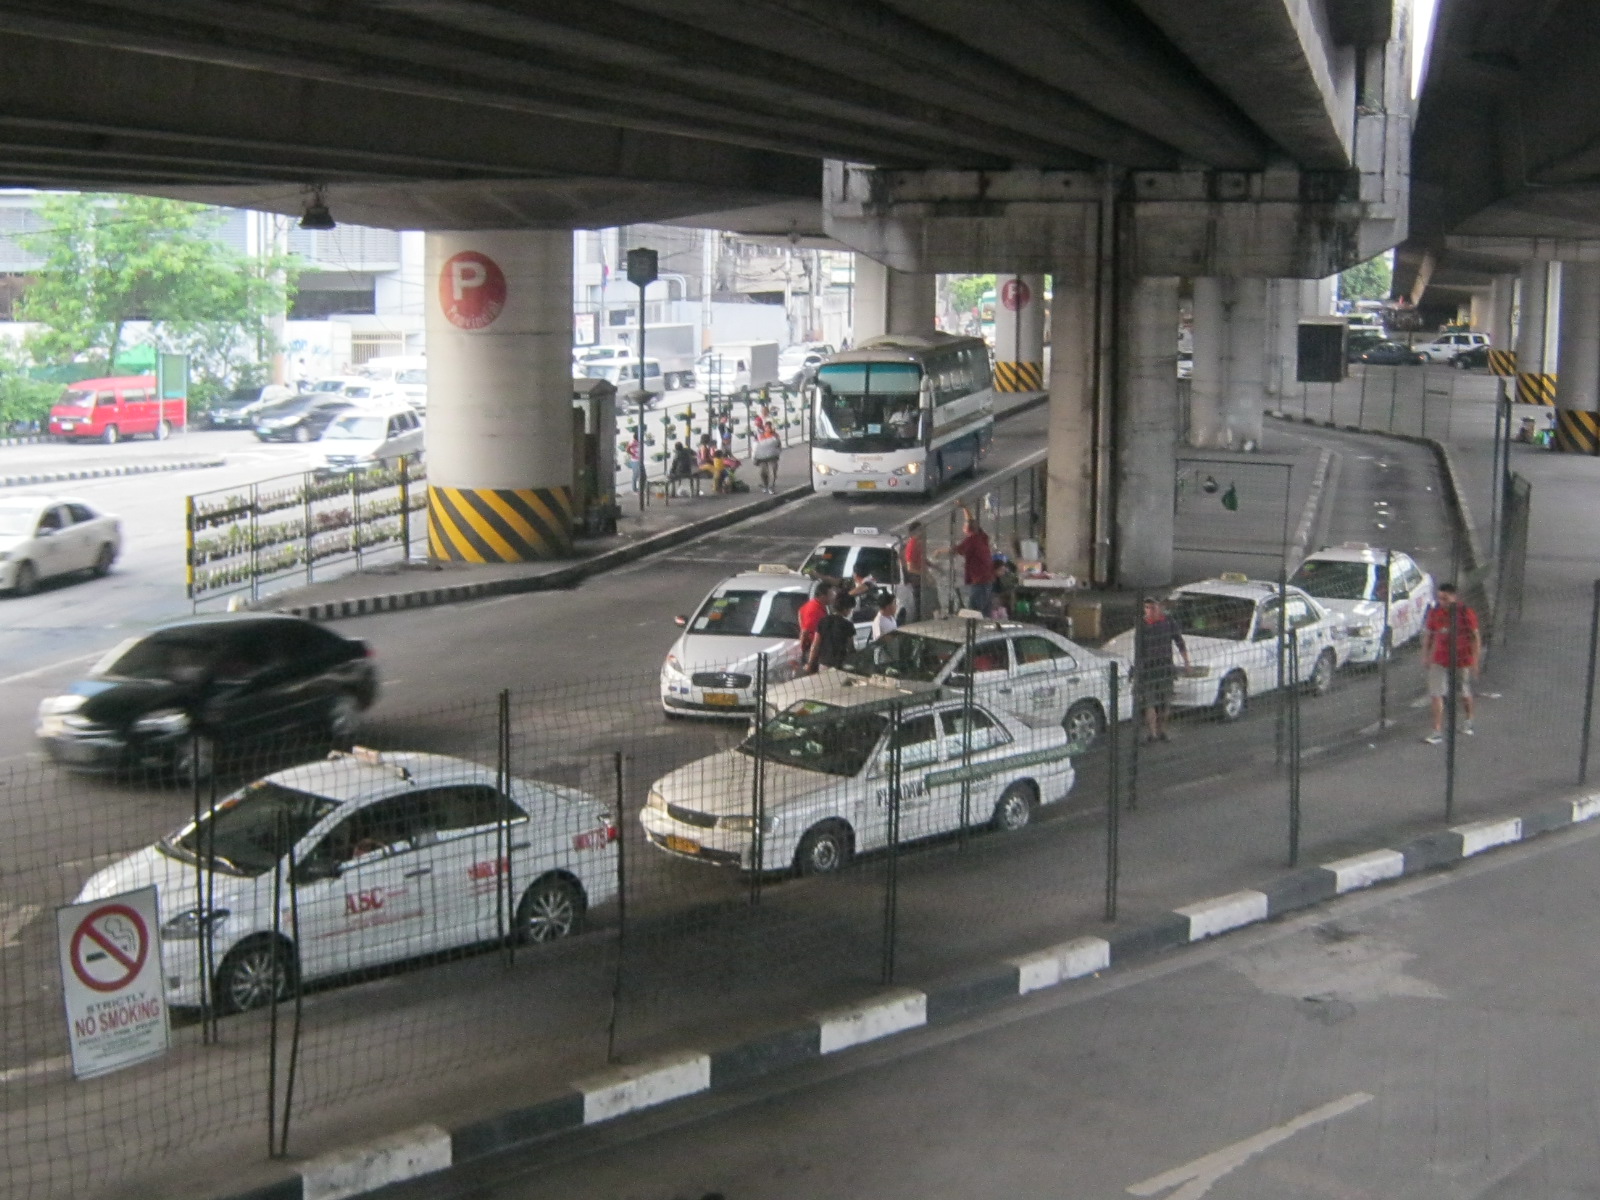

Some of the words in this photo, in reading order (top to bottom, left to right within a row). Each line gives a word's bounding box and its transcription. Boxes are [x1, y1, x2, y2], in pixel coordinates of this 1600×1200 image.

[452, 261, 487, 301] P
[344, 886, 386, 917] ASC
[75, 1015, 97, 1038] NO
[98, 997, 160, 1032] SMOKING
[86, 991, 146, 1014] STRICTLY
